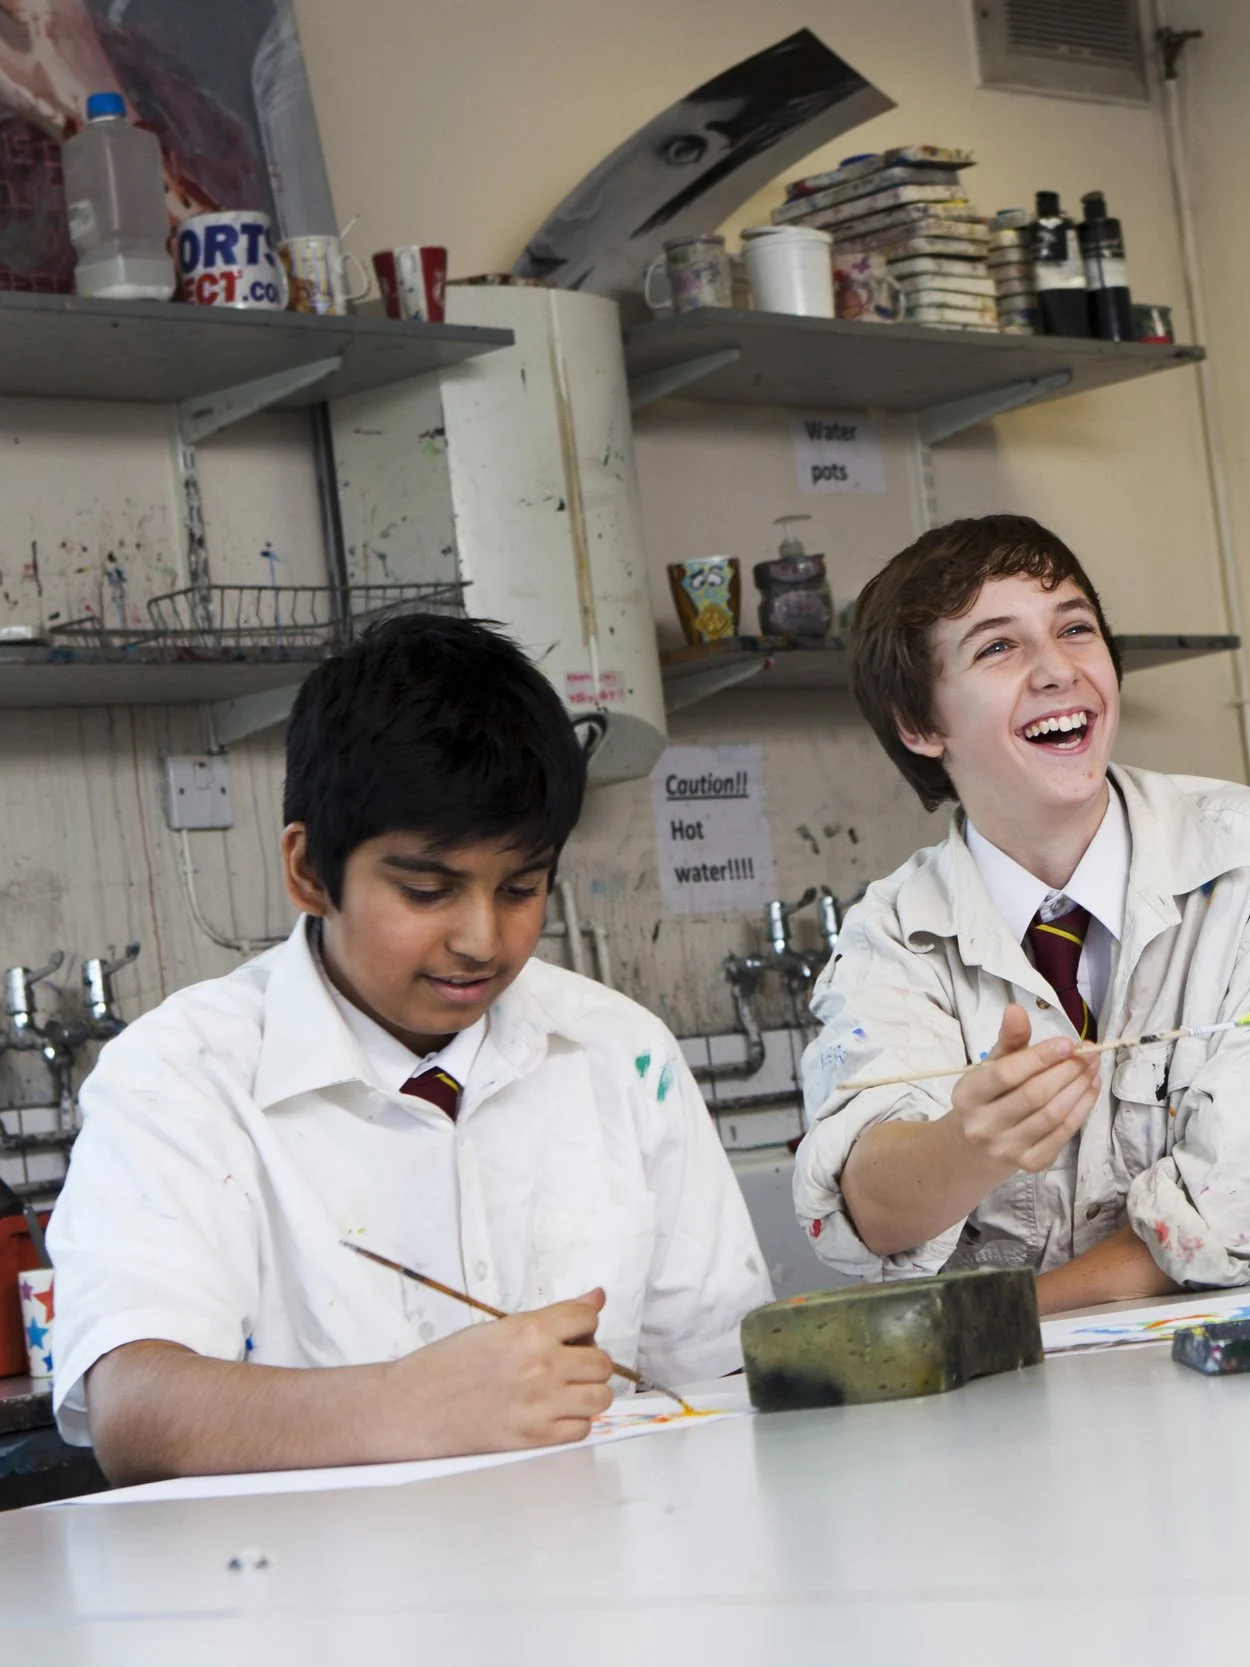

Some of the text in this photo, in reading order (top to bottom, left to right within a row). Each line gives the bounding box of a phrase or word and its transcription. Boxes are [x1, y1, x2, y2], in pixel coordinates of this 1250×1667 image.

[804, 419, 857, 441] Water
[811, 463, 848, 486] pots
[665, 771, 748, 796] Caution!!
[671, 819, 704, 840] Hot
